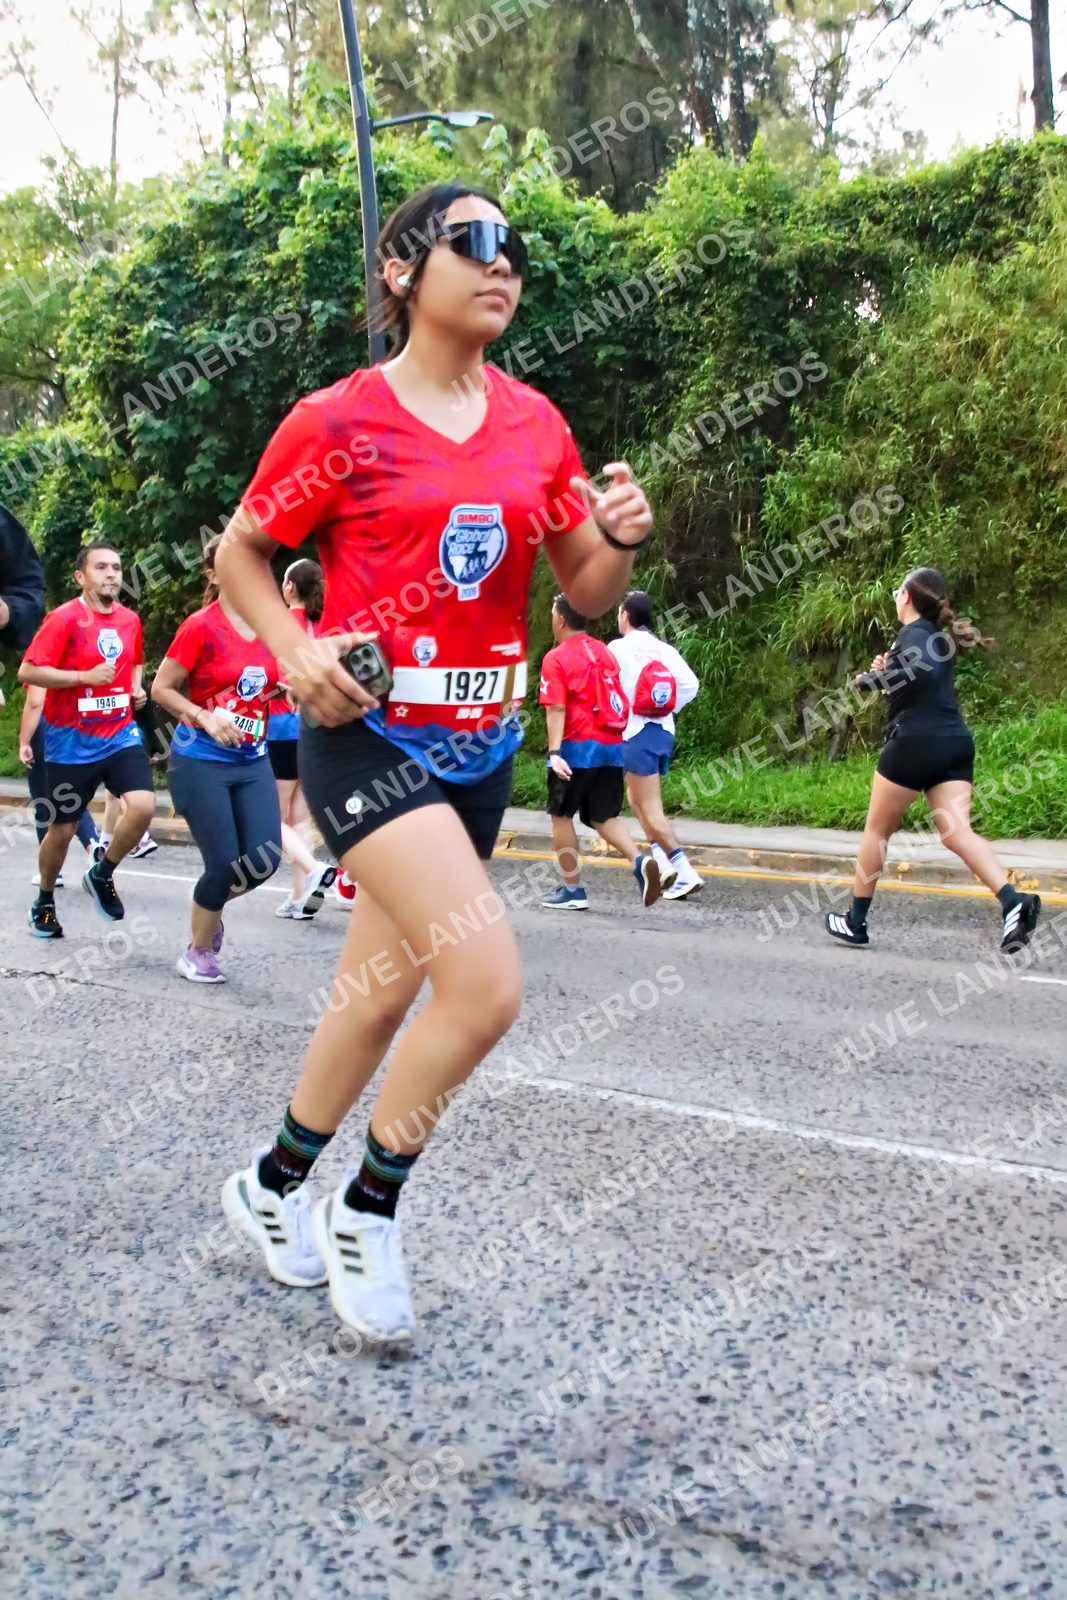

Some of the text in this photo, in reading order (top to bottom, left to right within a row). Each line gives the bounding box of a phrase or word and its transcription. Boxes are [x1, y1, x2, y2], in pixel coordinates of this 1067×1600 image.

[457, 514, 494, 524] BIMBO
[444, 670, 499, 702] 1927
[96, 697, 116, 709] 1946
